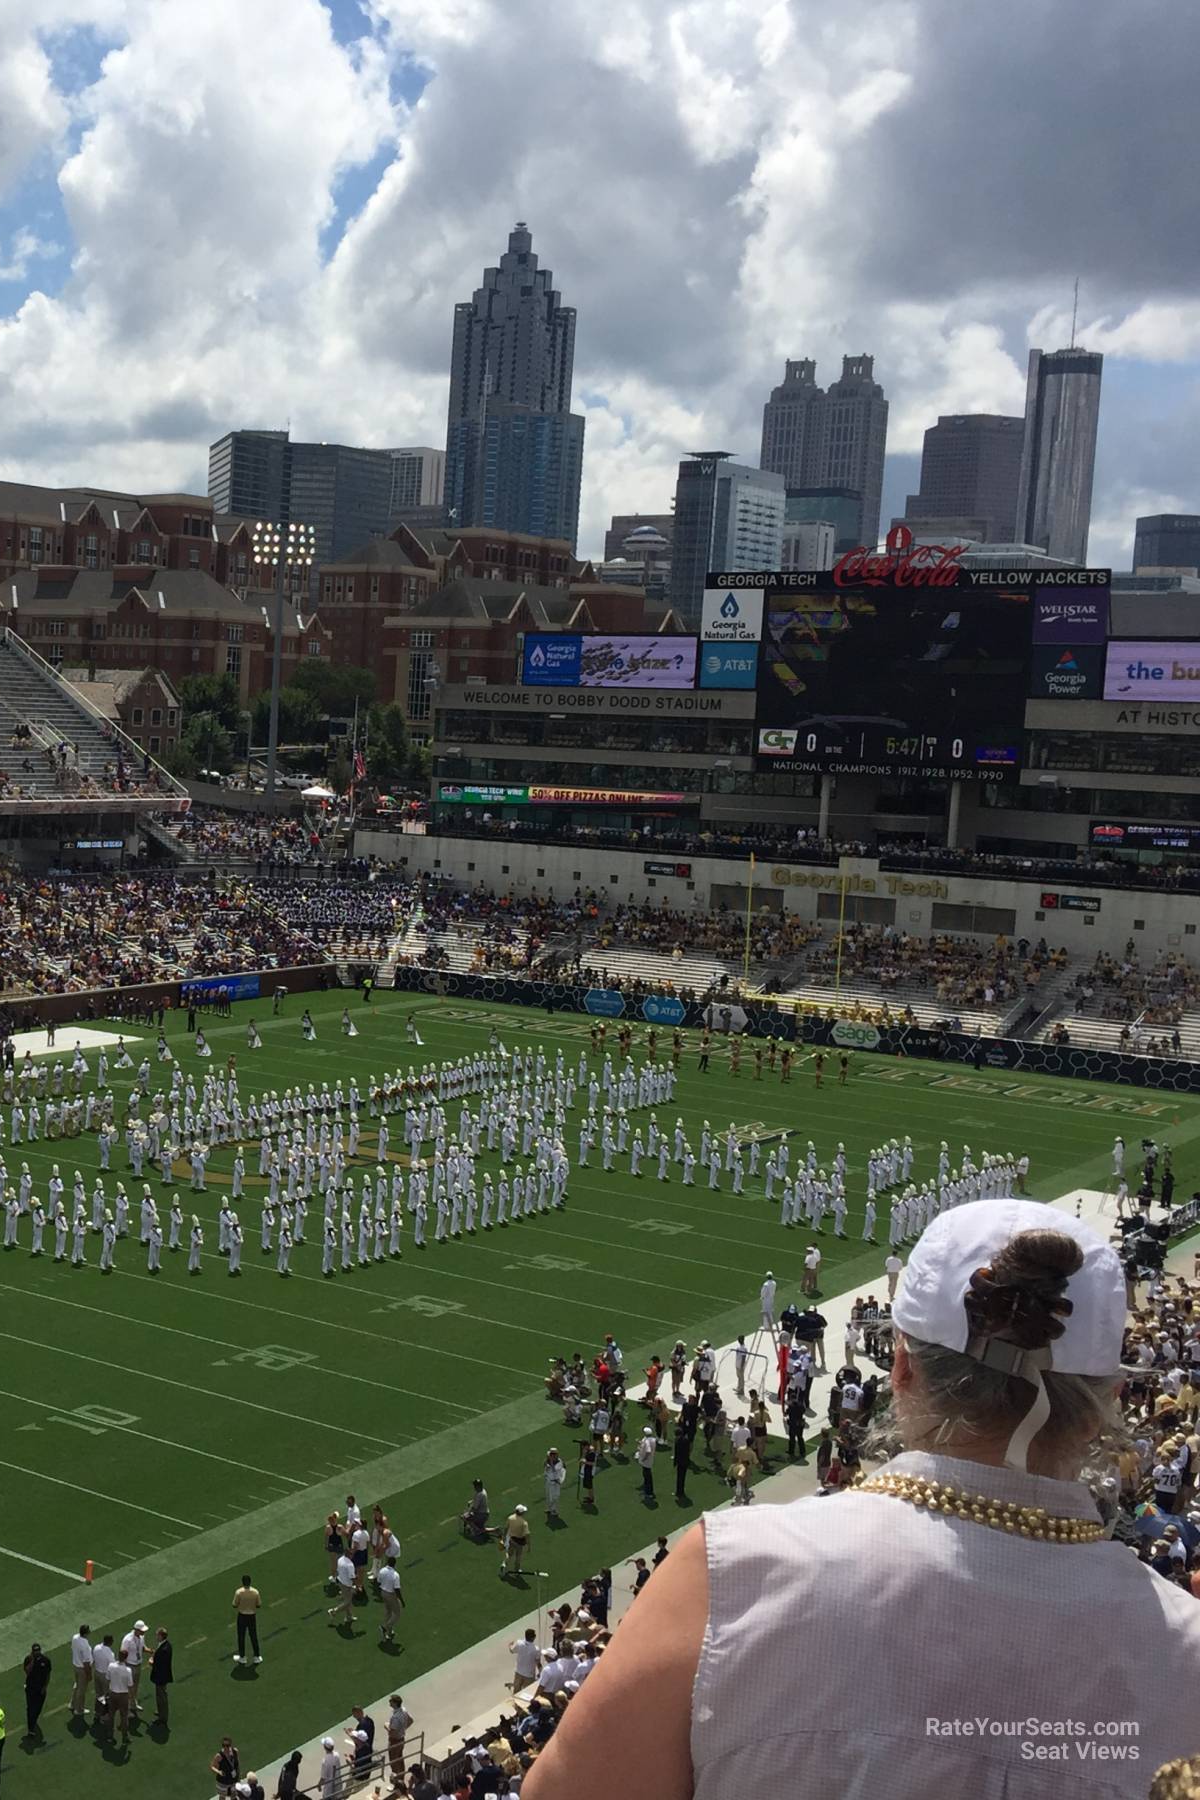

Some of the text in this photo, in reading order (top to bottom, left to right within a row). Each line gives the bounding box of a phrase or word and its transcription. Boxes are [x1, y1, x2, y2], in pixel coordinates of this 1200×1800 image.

[701, 465, 714, 475] W
[717, 574, 817, 586] GEORGIA TECH
[970, 571, 1108, 585] YELLOW JACKETS
[711, 620, 746, 633] Georgia
[704, 630, 756, 640] Natural Gas
[723, 659, 754, 672] AT&T
[1126, 661, 1164, 681] the
[1044, 672, 1087, 685] Georgia
[1048, 683, 1081, 695] Power
[463, 691, 722, 711] WELCOME TO BOBBY DODD STADIUM
[1116, 710, 1142, 724] AT
[806, 733, 817, 752] 0
[951, 738, 963, 759] 0
[773, 761, 823, 772] NATIONAL
[829, 763, 892, 775] CHAMPIONS
[978, 770, 1004, 780] 1990
[532, 788, 551, 799] 50%
[553, 791, 571, 801] OFF
[572, 791, 606, 802] PIZZAS
[609, 794, 645, 804] ONLINE
[770, 866, 949, 899] Georgia Tech
[660, 1006, 682, 1017] AT&T
[835, 1026, 877, 1045] sage
[844, 1390, 857, 1401] 59
[46, 1403, 143, 1436] 10
